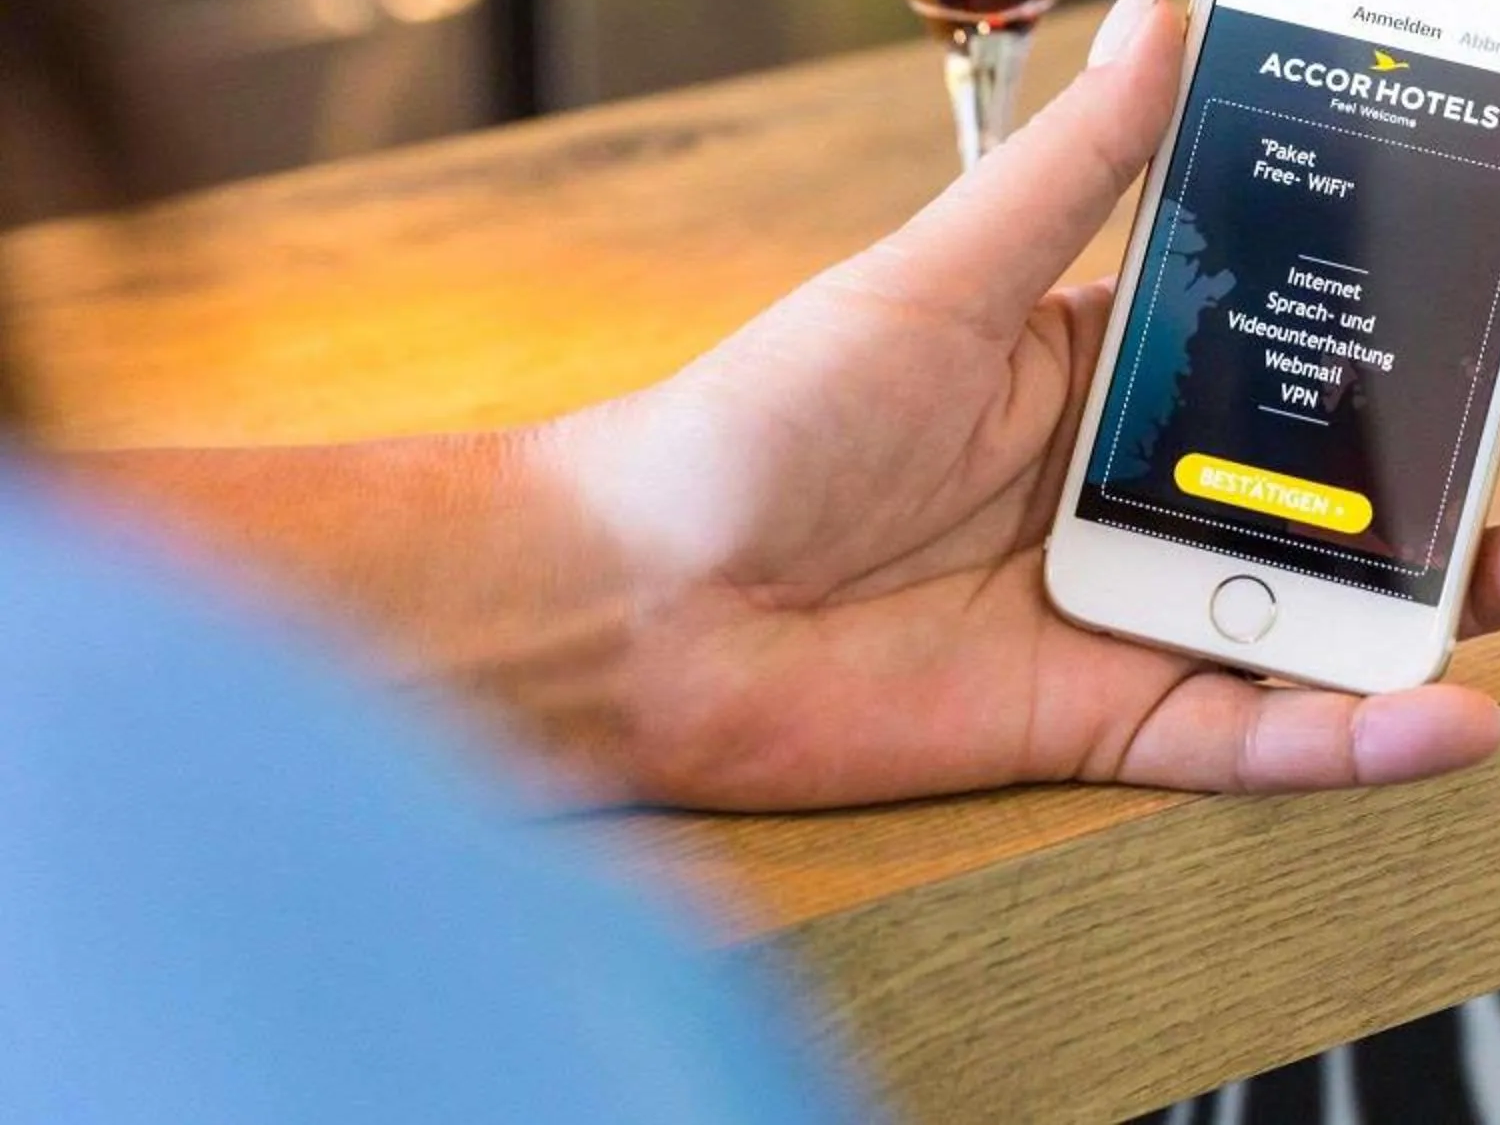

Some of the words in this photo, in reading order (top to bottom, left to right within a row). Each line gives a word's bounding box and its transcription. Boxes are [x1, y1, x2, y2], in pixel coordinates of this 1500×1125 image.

[1352, 5, 1443, 40] Anmelden
[1330, 98, 1356, 113] Feel
[1359, 104, 1417, 128] Welcome
[1287, 266, 1362, 301] Internet
[1266, 291, 1335, 323] Sprach-
[1340, 314, 1376, 334] und
[1228, 310, 1395, 372] Videounterhaltung
[1265, 349, 1343, 385] Webmail
[1281, 383, 1319, 408] VPN
